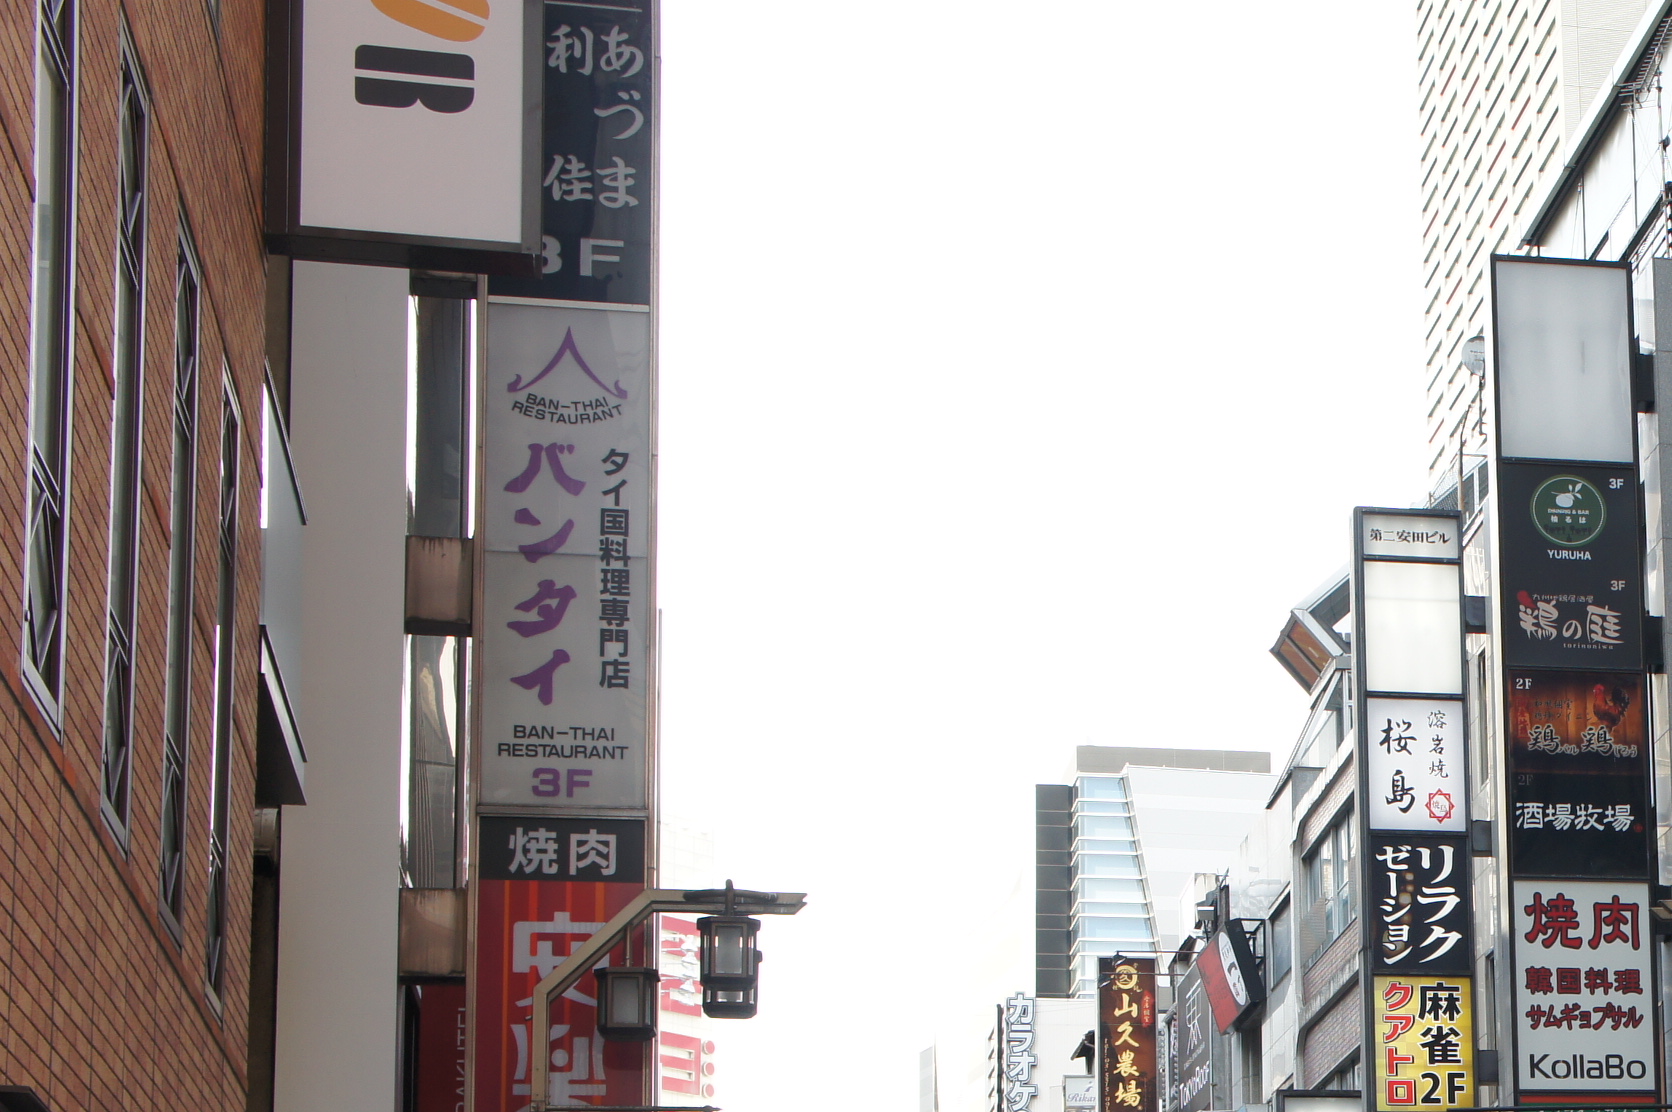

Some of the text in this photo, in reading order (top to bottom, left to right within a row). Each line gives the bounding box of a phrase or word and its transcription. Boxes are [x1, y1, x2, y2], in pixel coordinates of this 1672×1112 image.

[594, 24, 645, 209] あづま
[511, 401, 625, 425] RESTAURANT
[525, 392, 609, 413] BAN-THAI
[1609, 478, 1624, 489] 3F
[1369, 528, 1450, 544] 第二安田ビル
[598, 448, 631, 690] タイ国料理専門店
[1547, 549, 1592, 561] YURUHA
[503, 442, 587, 706] バンタイ
[1610, 580, 1626, 591] 3F
[1515, 678, 1532, 690] 2F
[513, 725, 615, 743] BAN-THAI
[1426, 711, 1449, 779] 溶岩焼
[497, 742, 629, 761] RESTAURANT
[1379, 718, 1418, 814] 桜島
[531, 767, 592, 798] 3F
[1515, 802, 1635, 832] 酒場牧場
[508, 827, 617, 877] 焼肉
[1375, 845, 1413, 965] ゼーション
[1416, 845, 1463, 964] リラク
[1523, 892, 1641, 950] 焼肉
[1525, 966, 1643, 995] 韓国料理
[1418, 981, 1464, 1066] 麻雀
[1525, 1002, 1644, 1031] サムギョプサル
[1383, 981, 1416, 1106] クアトロ
[1529, 1053, 1647, 1080] KollaBo
[1420, 1072, 1466, 1105] 2F
